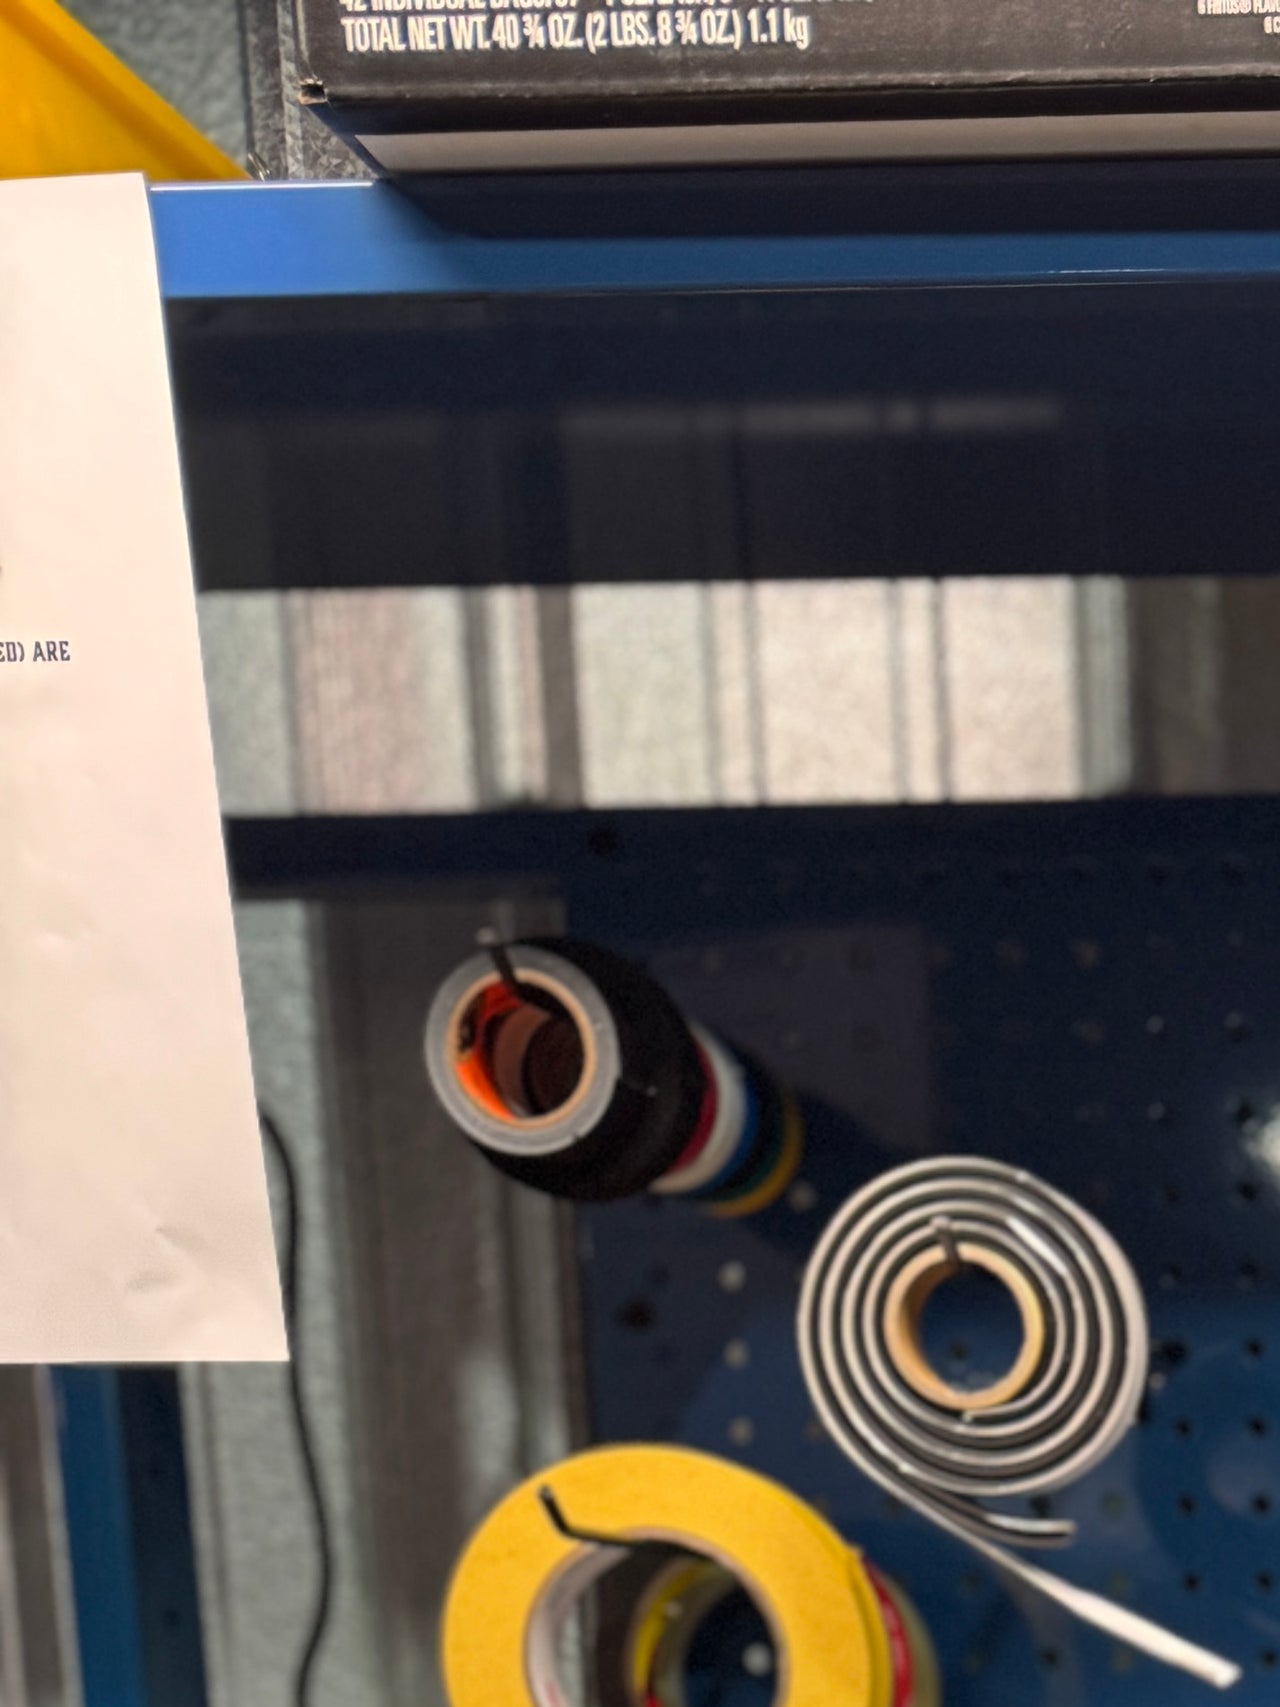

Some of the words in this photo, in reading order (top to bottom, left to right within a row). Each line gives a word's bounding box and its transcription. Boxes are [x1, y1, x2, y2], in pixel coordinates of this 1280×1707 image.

[340, 15, 406, 52] TOTAL
[407, 14, 447, 51] NET
[491, 13, 521, 50] 40
[547, 12, 583, 49] OZ.
[610, 10, 655, 47] LBS.
[656, 10, 673, 46] 8
[699, 8, 742, 50] OZ.)
[747, 8, 778, 44] 1.1
[782, 7, 810, 49] kg
[33, 640, 71, 662] ARE
